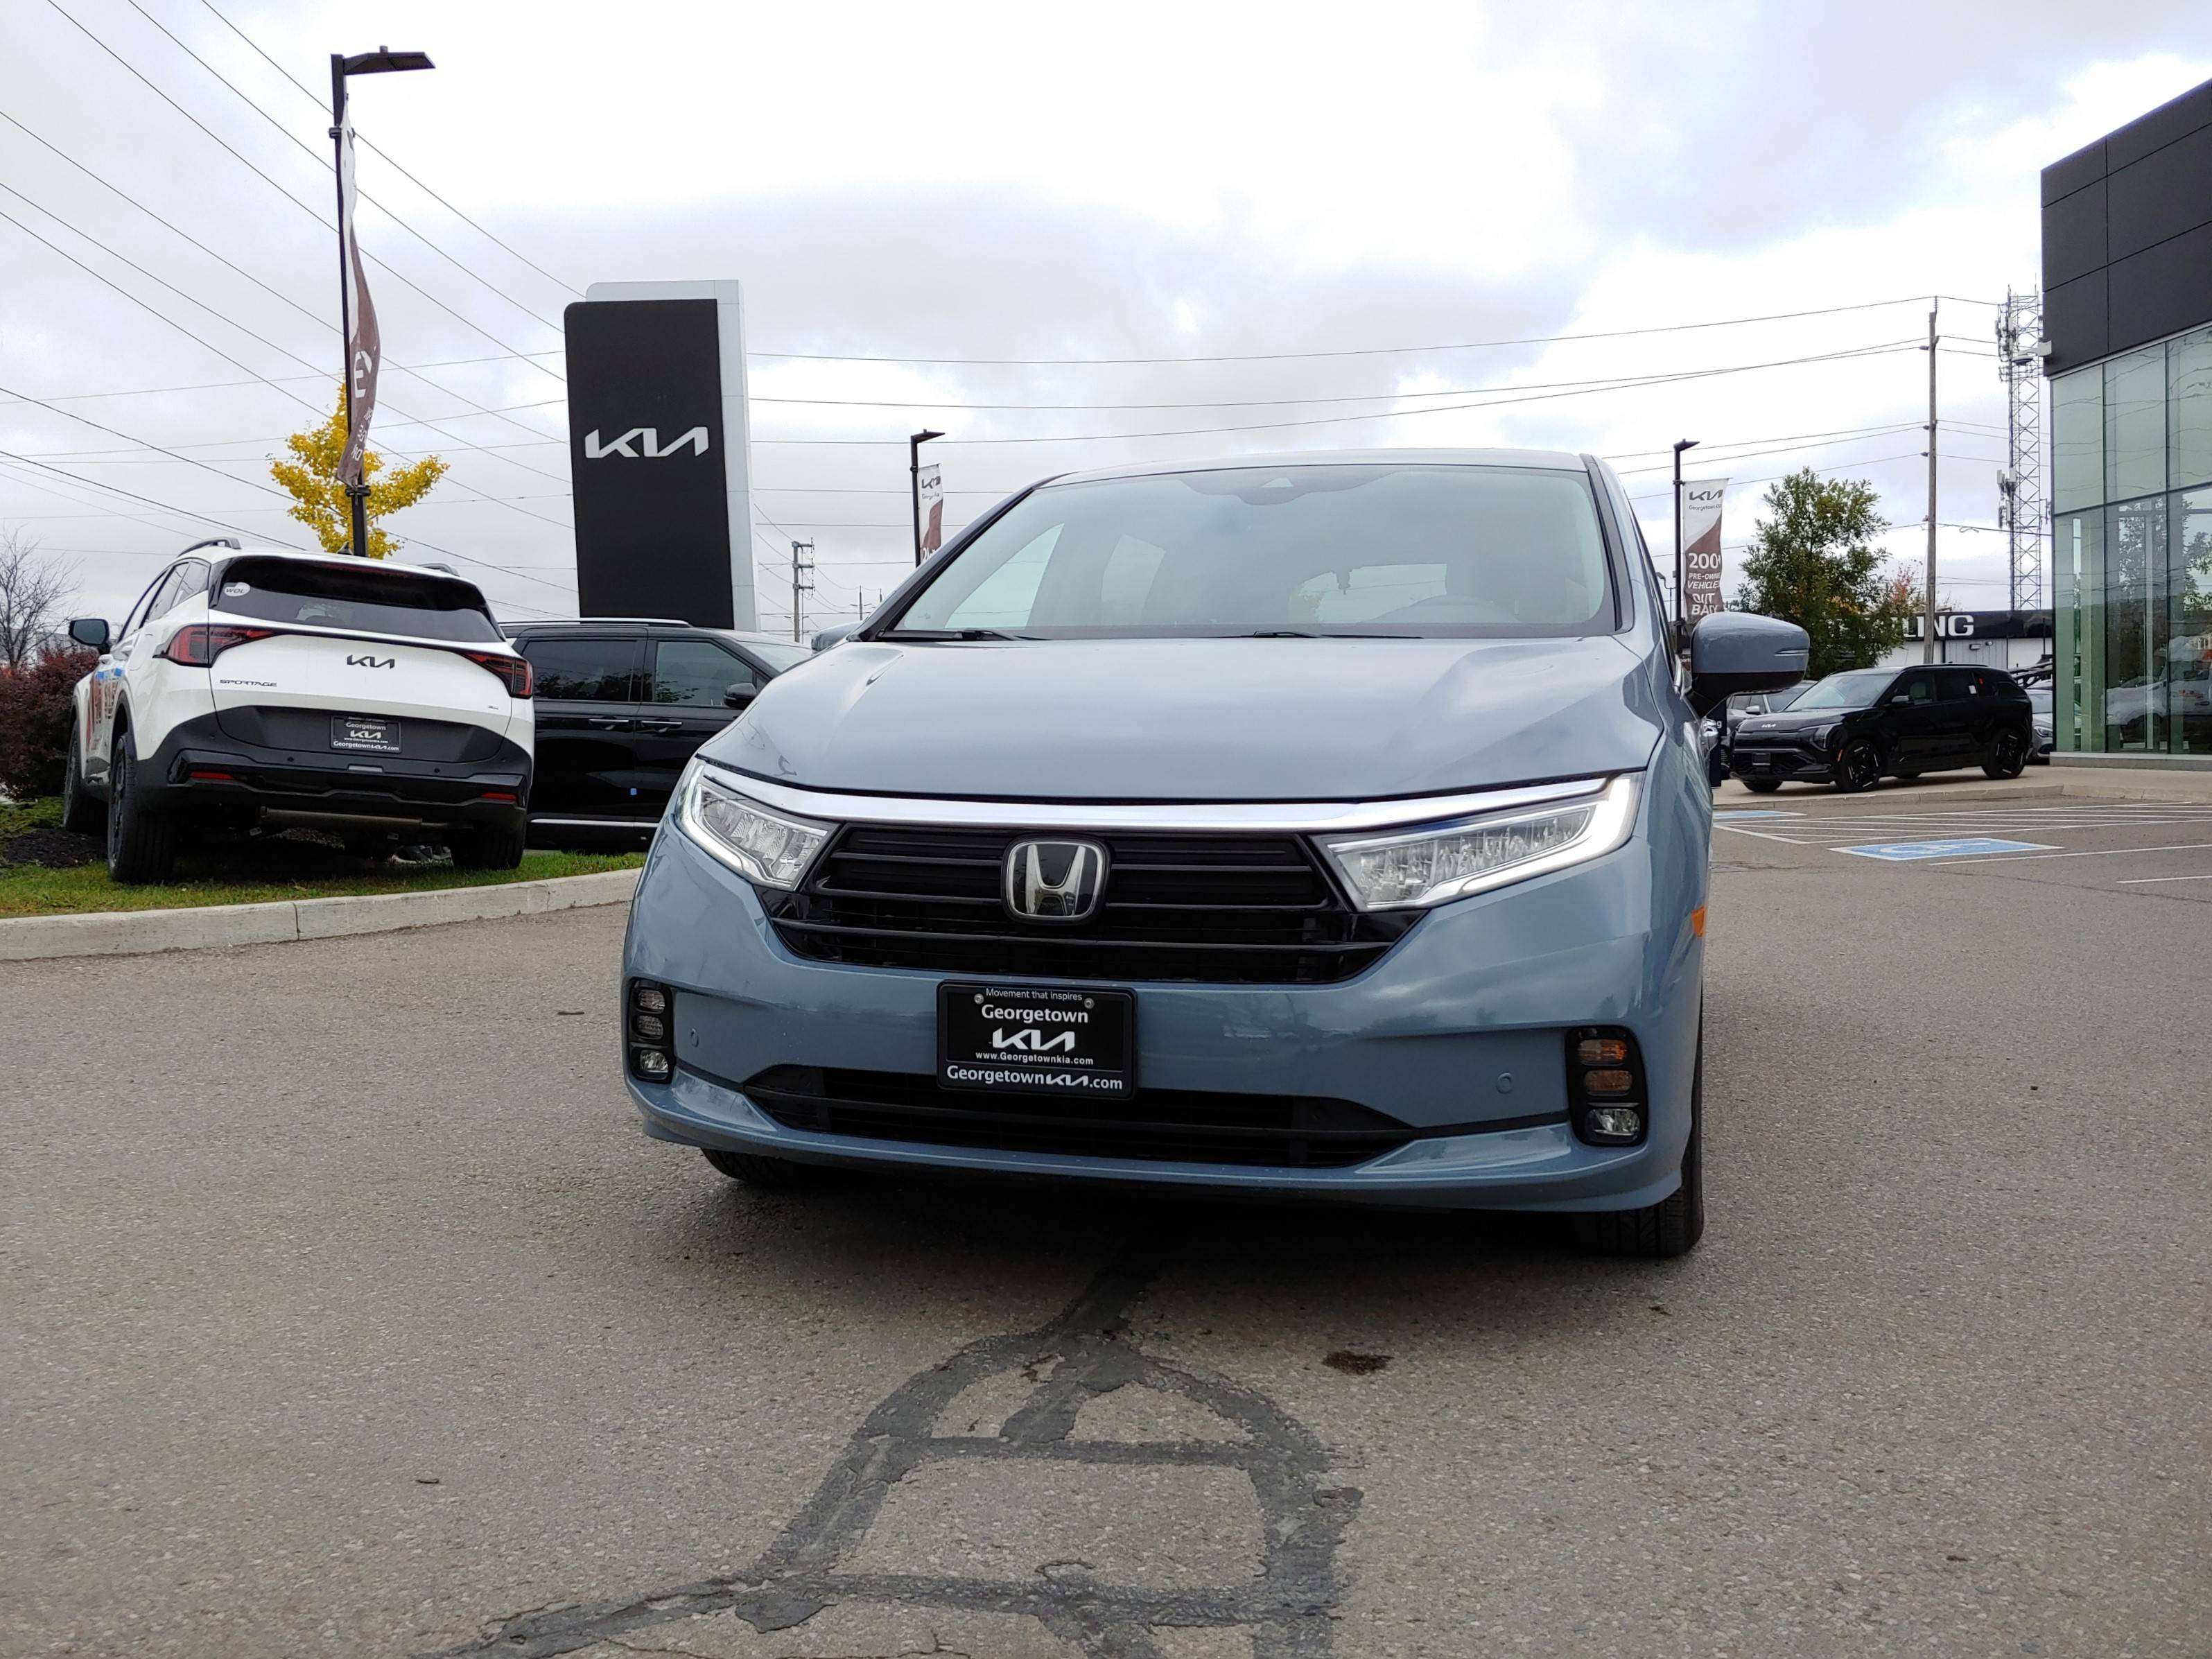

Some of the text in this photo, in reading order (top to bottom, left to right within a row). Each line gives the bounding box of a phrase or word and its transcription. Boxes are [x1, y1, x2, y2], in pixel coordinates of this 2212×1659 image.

[585, 426, 709, 458] KIA
[347, 654, 395, 669] KIA
[986, 988, 1083, 1002] Movement that inspires
[981, 1004, 1088, 1024] Georgetown
[992, 1027, 1075, 1052] KIA
[975, 1052, 1094, 1066] www.Georgetownkia.com
